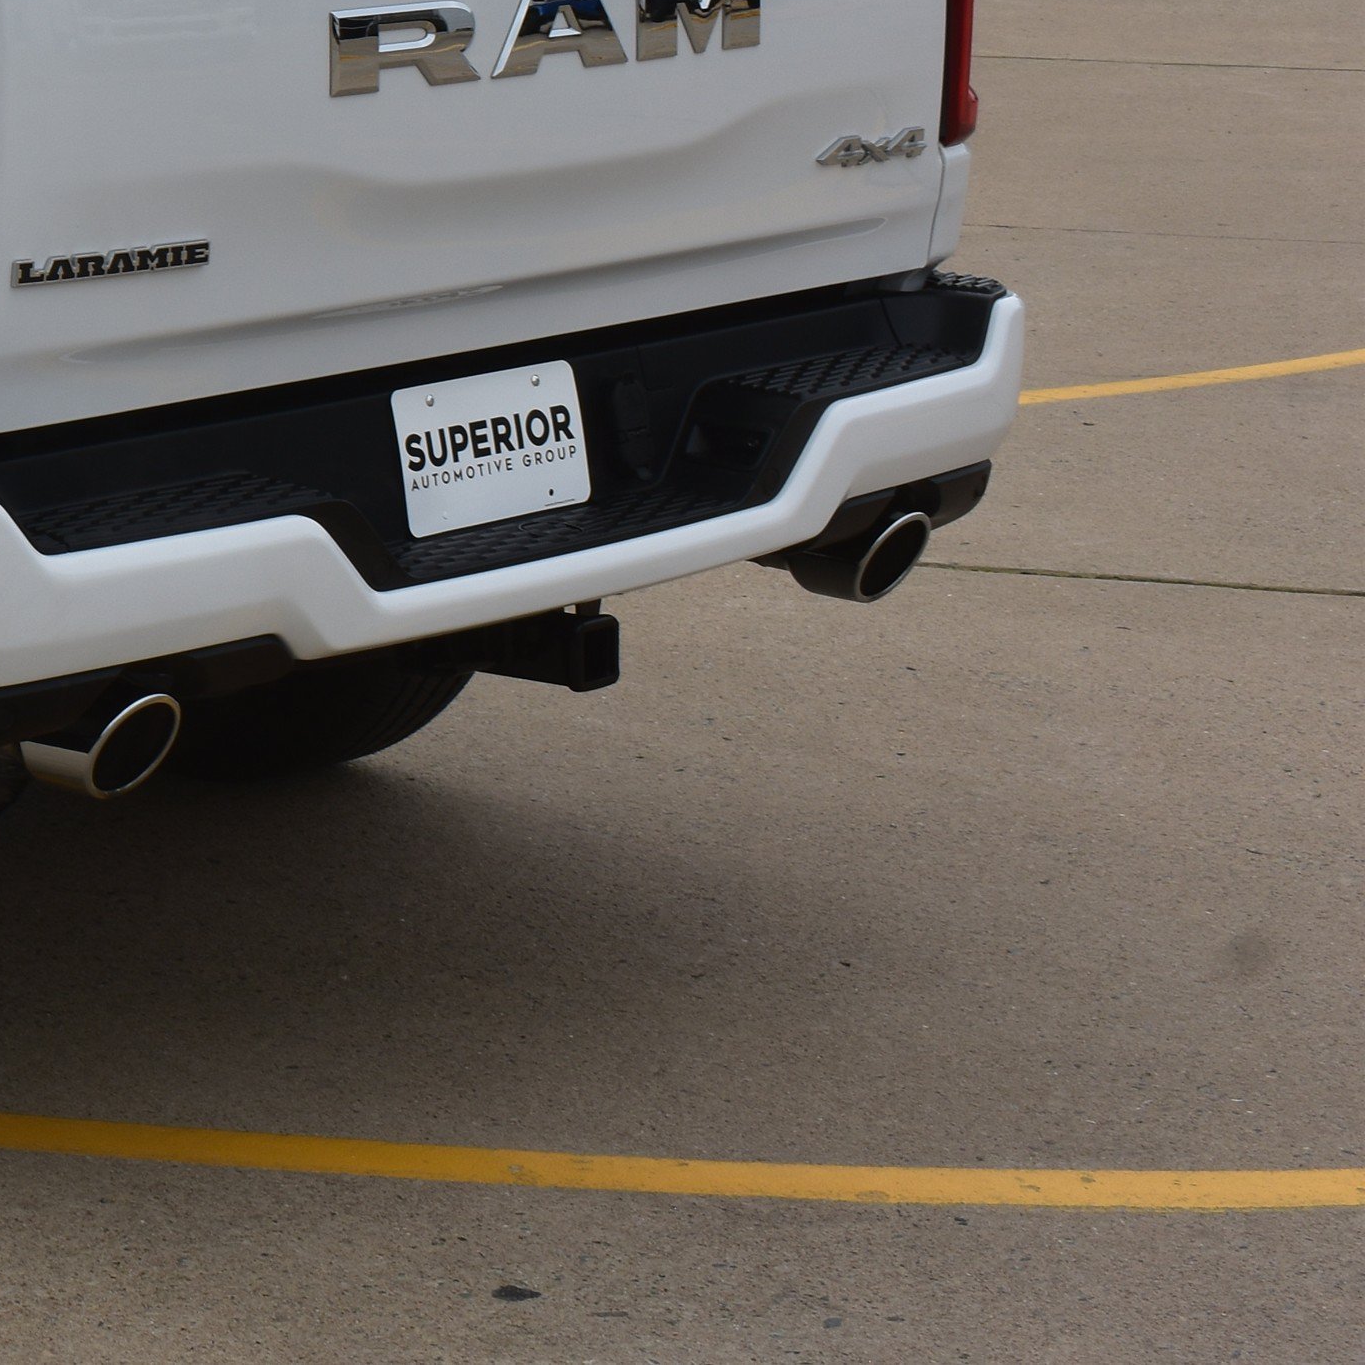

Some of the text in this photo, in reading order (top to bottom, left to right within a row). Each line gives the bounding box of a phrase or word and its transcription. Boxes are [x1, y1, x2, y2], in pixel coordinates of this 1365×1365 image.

[815, 126, 927, 167] 4x4
[12, 239, 210, 287] LARAMIE
[405, 404, 575, 472] SUPERIOR
[411, 445, 577, 492] AUTOMOTIVE GROUP
